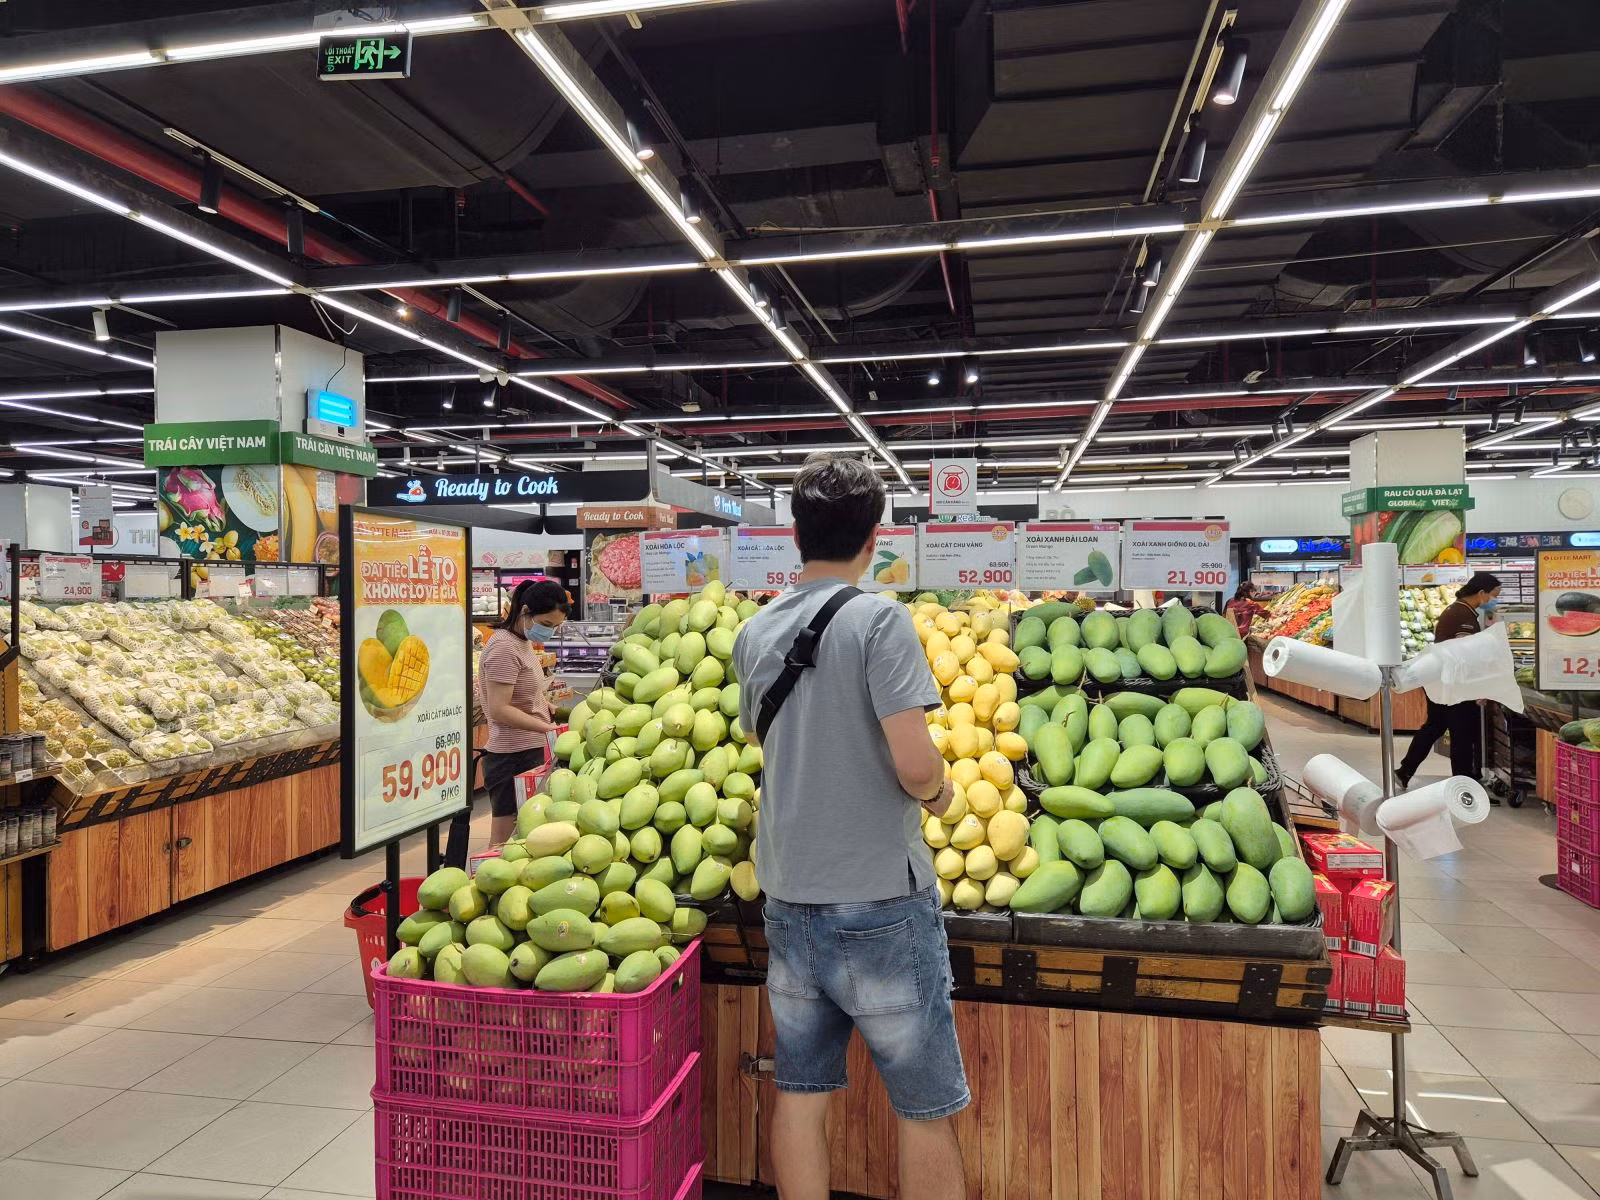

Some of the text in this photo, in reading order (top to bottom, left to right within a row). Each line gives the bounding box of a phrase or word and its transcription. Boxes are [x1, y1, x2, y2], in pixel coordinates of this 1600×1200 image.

[327, 55, 352, 64] EXIT
[148, 435, 266, 452] TRÁI CÂY VIỆT NAM
[296, 437, 375, 463] TRÁI CÂY VIỆT NAM
[435, 476, 559, 501] Ready to Cook
[1435, 488, 1447, 496] ĐÀ
[1448, 489, 1463, 497] LẠT
[583, 511, 644, 523] Ready to Cook
[645, 542, 659, 550] XOÀI
[1026, 535, 1043, 543] XOÀI
[1065, 535, 1078, 543] ĐÀI
[408, 544, 430, 580] LỄ
[431, 556, 455, 581] TO
[767, 571, 801, 587] 59,9
[959, 569, 1012, 585] 52,900
[1167, 570, 1227, 586] 21,900
[64, 586, 93, 597] 24,900
[363, 578, 408, 599] KHÔNG
[1562, 657, 1600, 678] 12,
[417, 707, 431, 723] XOÀI
[435, 731, 461, 750] 65,900
[382, 746, 461, 803] 59,900
[440, 784, 460, 801] Đ/KG
